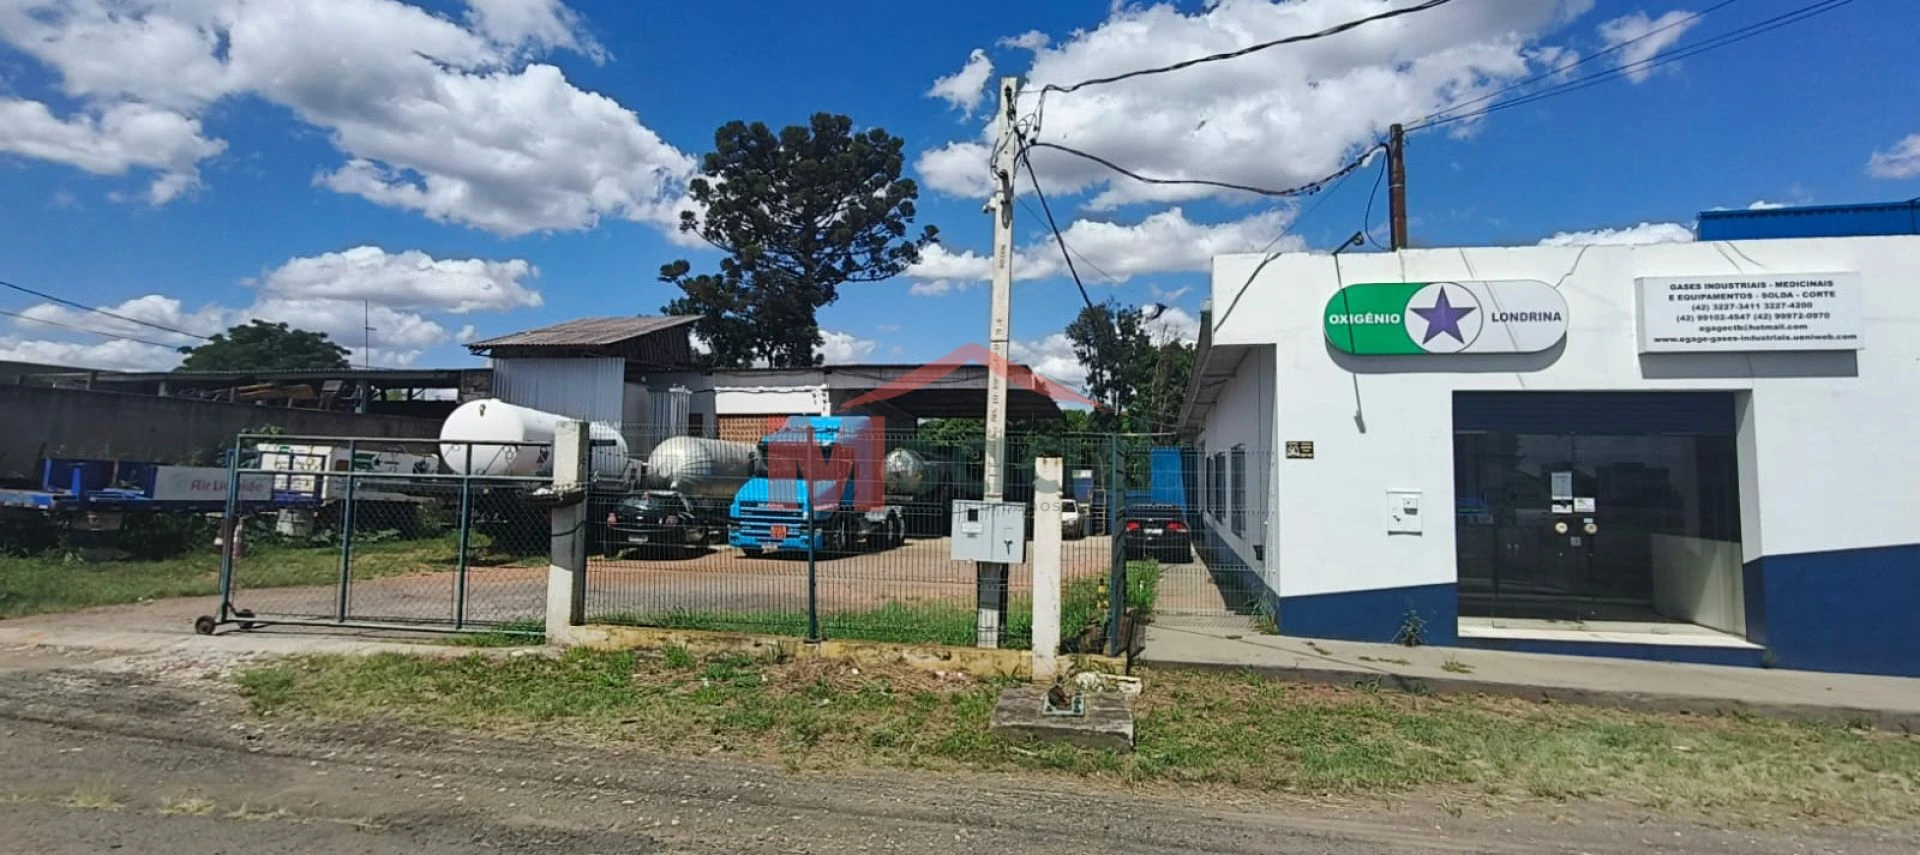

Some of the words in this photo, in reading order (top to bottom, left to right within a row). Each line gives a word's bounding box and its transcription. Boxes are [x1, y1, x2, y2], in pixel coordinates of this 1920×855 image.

[1669, 283, 1701, 291] GASES
[1704, 282, 1767, 290] INDUSTRIAIS
[1775, 280, 1834, 289] MEDICINAIS
[1677, 292, 1753, 301] EQUIPAMENTOS
[1761, 291, 1793, 299] SOLDA
[1802, 290, 1836, 298] CORTE
[1691, 304, 1710, 312] (42)
[1328, 311, 1400, 325] OXIGÊNIO
[1491, 311, 1562, 323] LONDRINA
[1676, 314, 1694, 323] (42)
[1753, 313, 1772, 321] (42)
